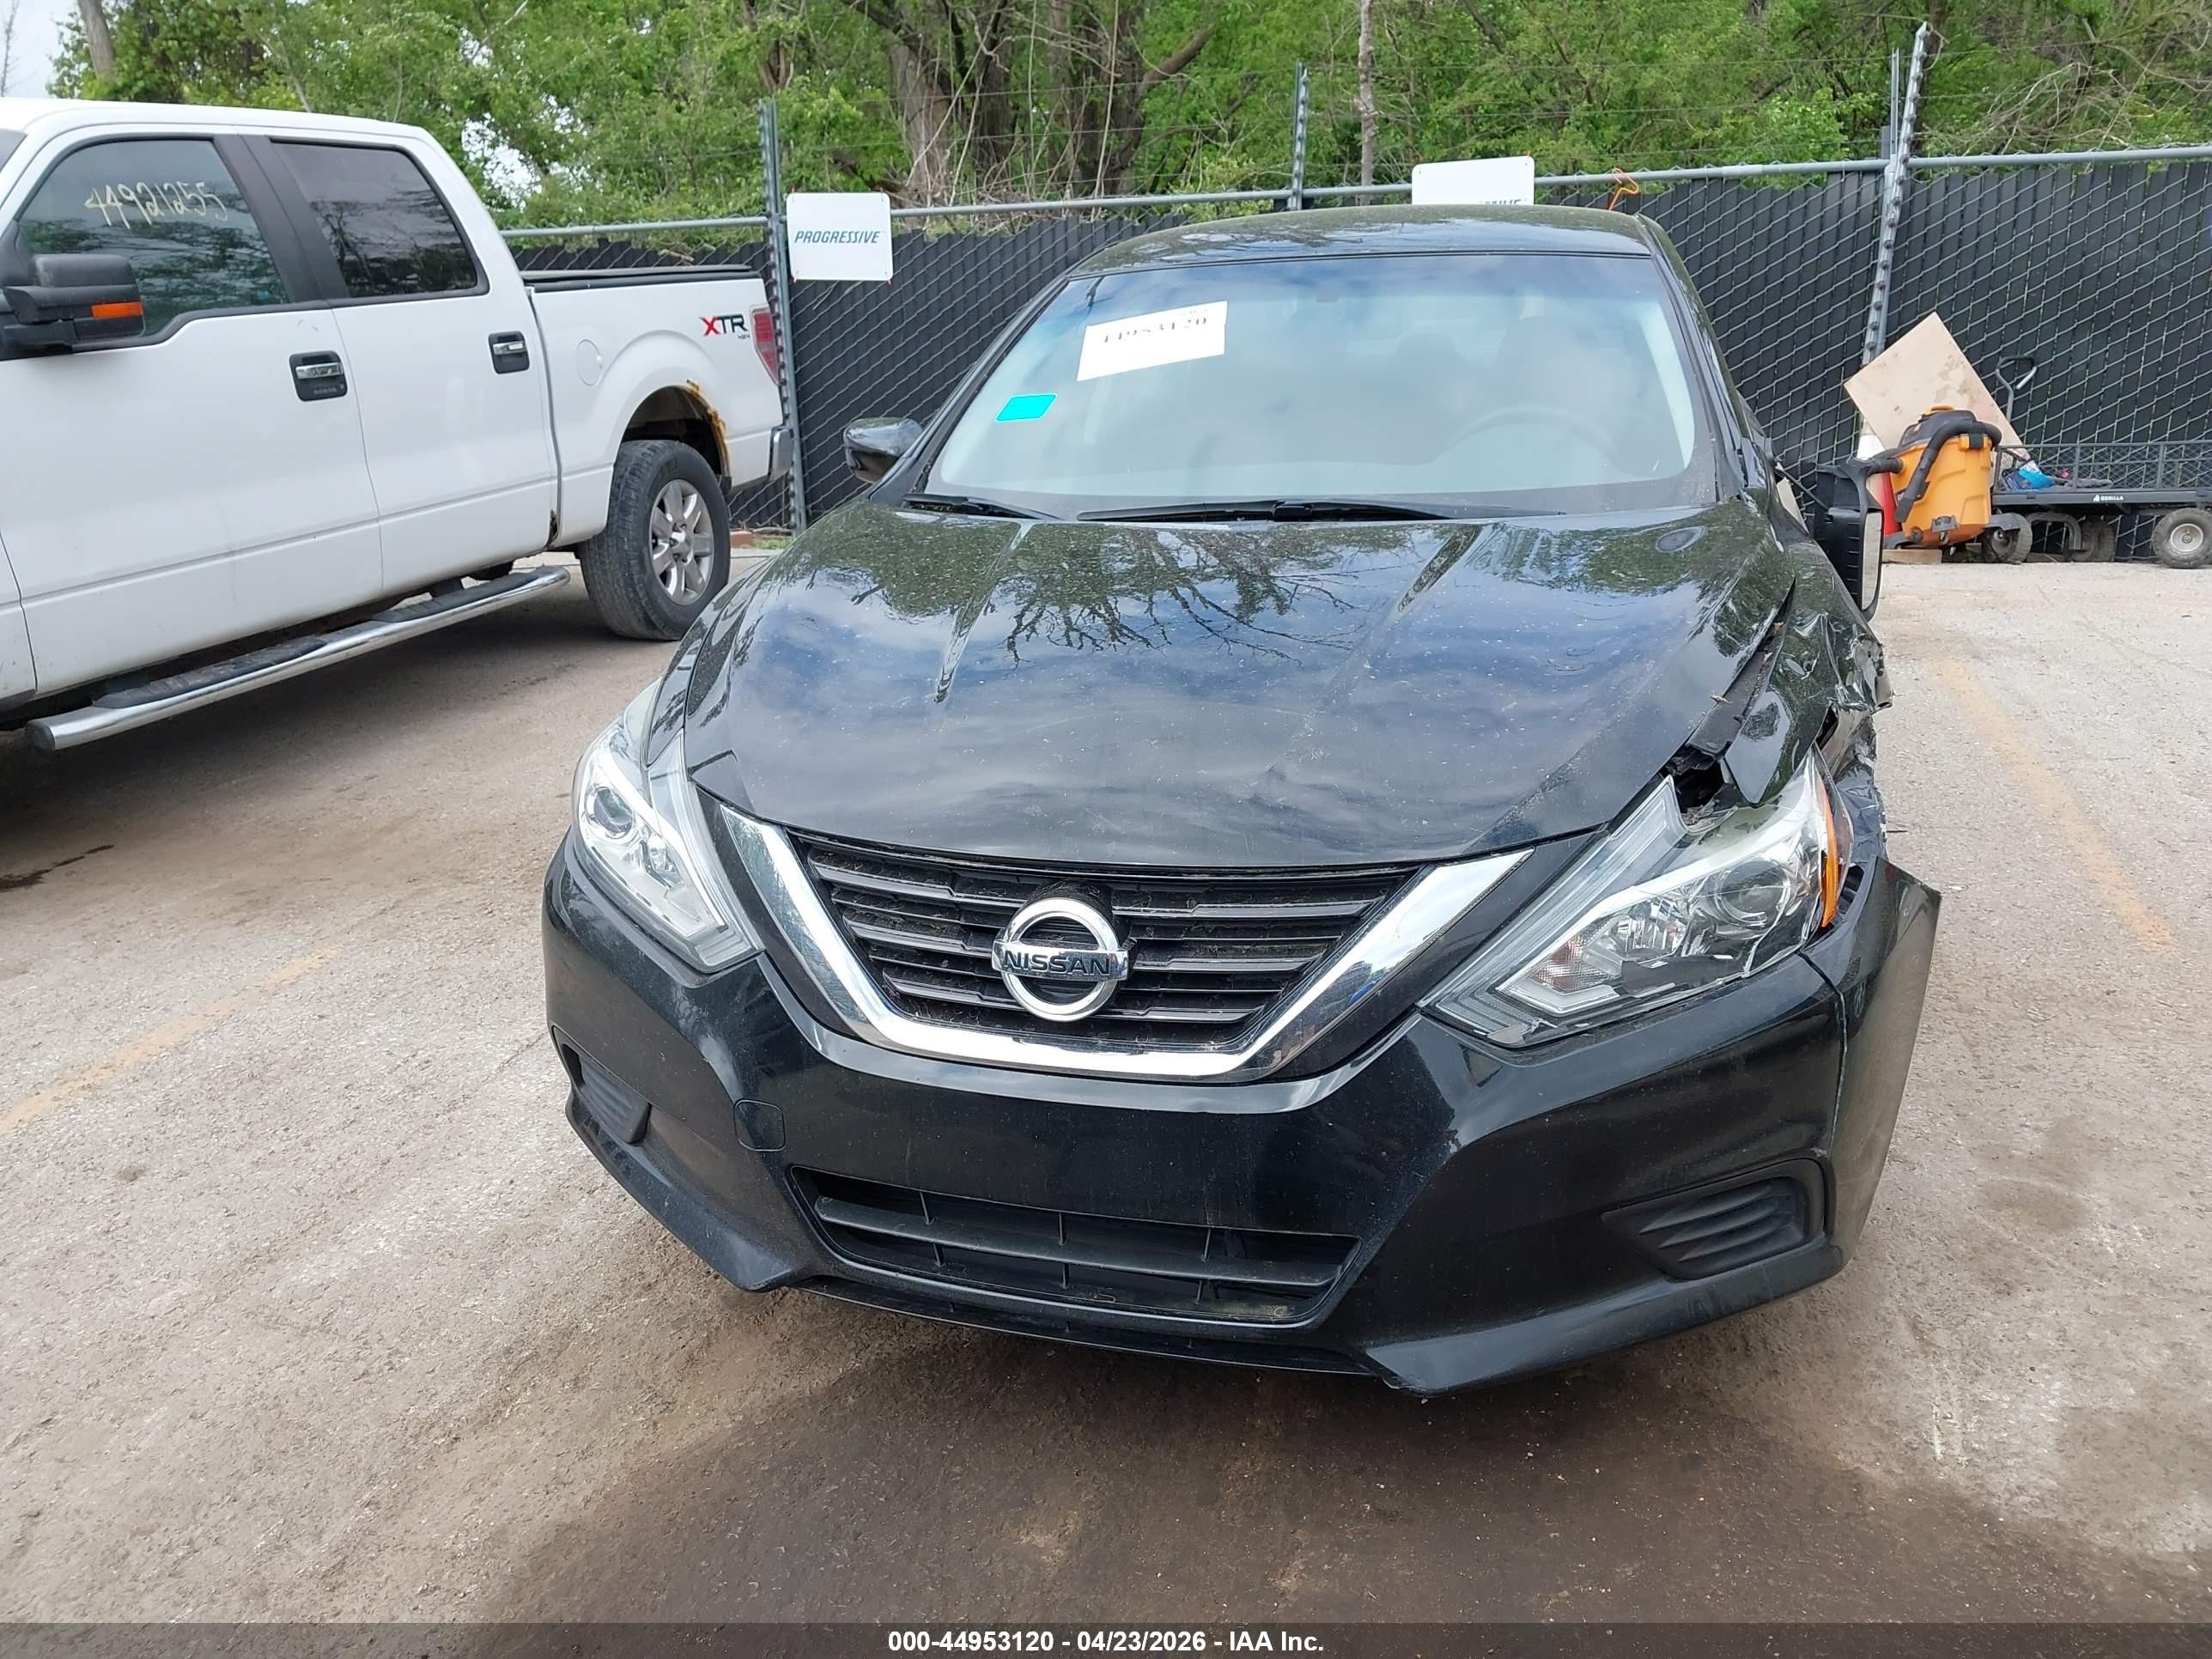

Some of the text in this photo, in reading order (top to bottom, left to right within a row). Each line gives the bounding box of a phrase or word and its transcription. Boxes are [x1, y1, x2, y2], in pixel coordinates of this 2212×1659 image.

[83, 180, 228, 229] 44921255
[793, 230, 880, 244] PROGRESSIVE
[699, 313, 749, 337] XTR
[1003, 950, 1110, 975] NISSAN
